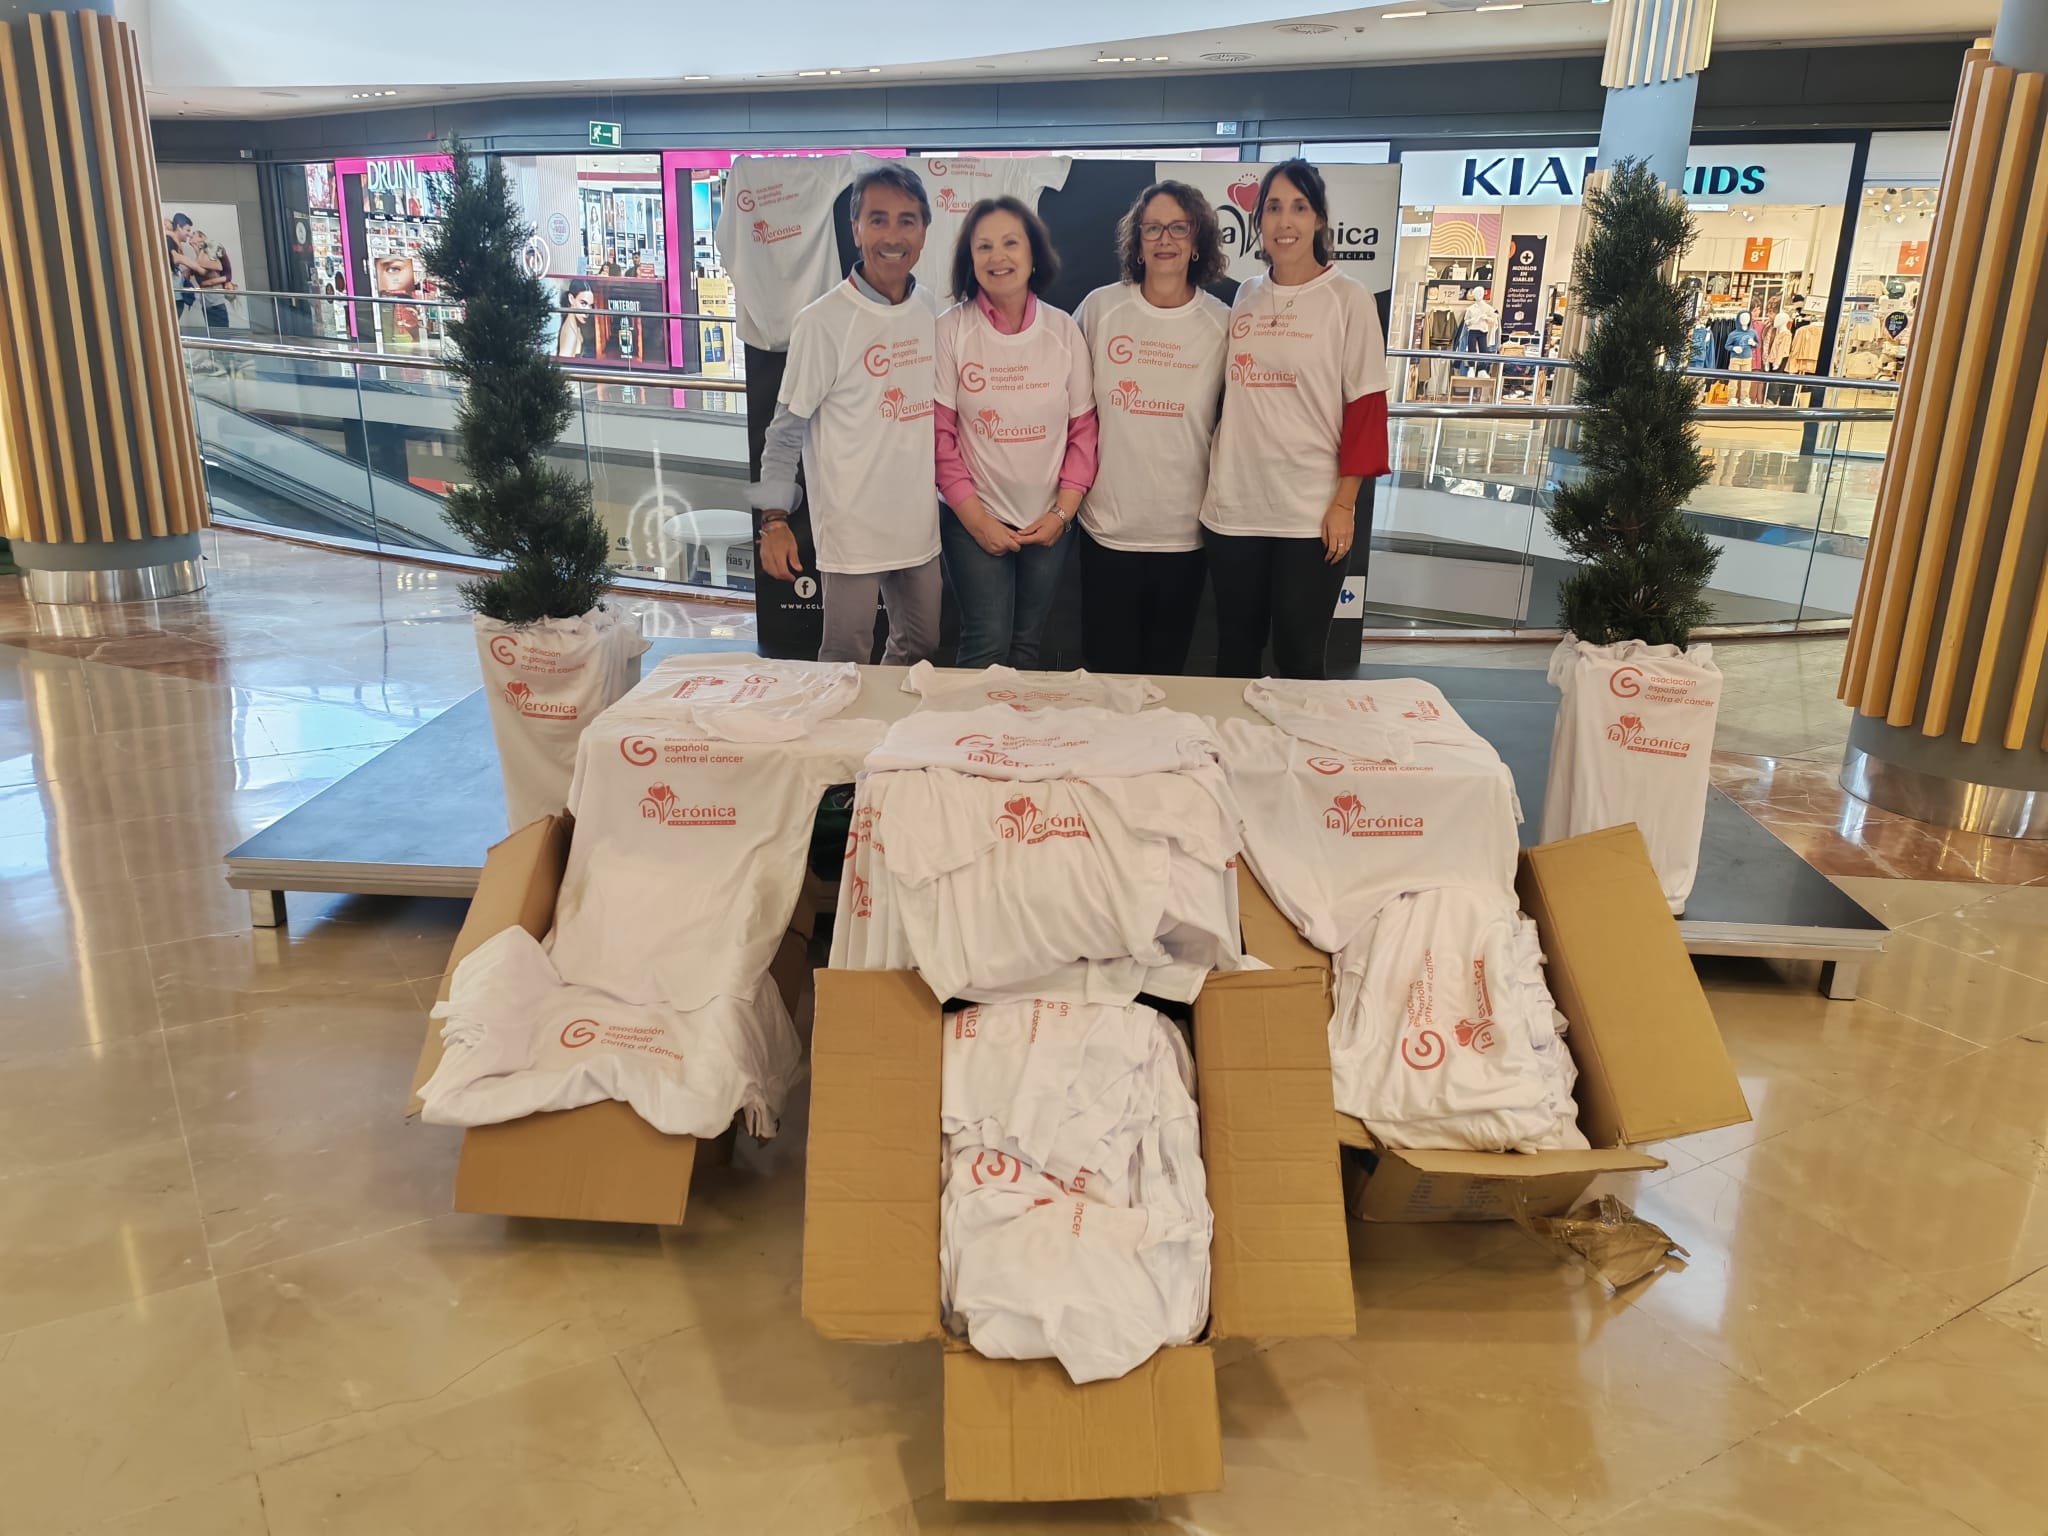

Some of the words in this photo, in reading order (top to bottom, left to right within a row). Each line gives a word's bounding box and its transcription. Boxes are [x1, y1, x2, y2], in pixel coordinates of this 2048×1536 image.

[367, 159, 416, 190] DRUNI
[1256, 321, 1289, 329] espaola
[1140, 340, 1181, 351] asociación
[1138, 348, 1174, 359] española
[1137, 358, 1164, 367] contra
[1164, 360, 1171, 368] el
[989, 365, 1029, 374] asociación
[990, 374, 1025, 384] española
[1017, 383, 1024, 391] el
[1025, 381, 1050, 390] cáncer
[521, 664, 546, 673] contra
[1650, 675, 1697, 686] asociación
[1647, 685, 1688, 695] española
[1644, 693, 1673, 703] contra
[1674, 695, 1683, 704] el
[1684, 697, 1715, 707] cáncer
[664, 743, 709, 754] española
[665, 755, 697, 763] contra
[699, 754, 708, 763] el
[710, 753, 744, 763] cáncer
[608, 1025, 665, 1036] asociación
[600, 1038, 635, 1049] contra
